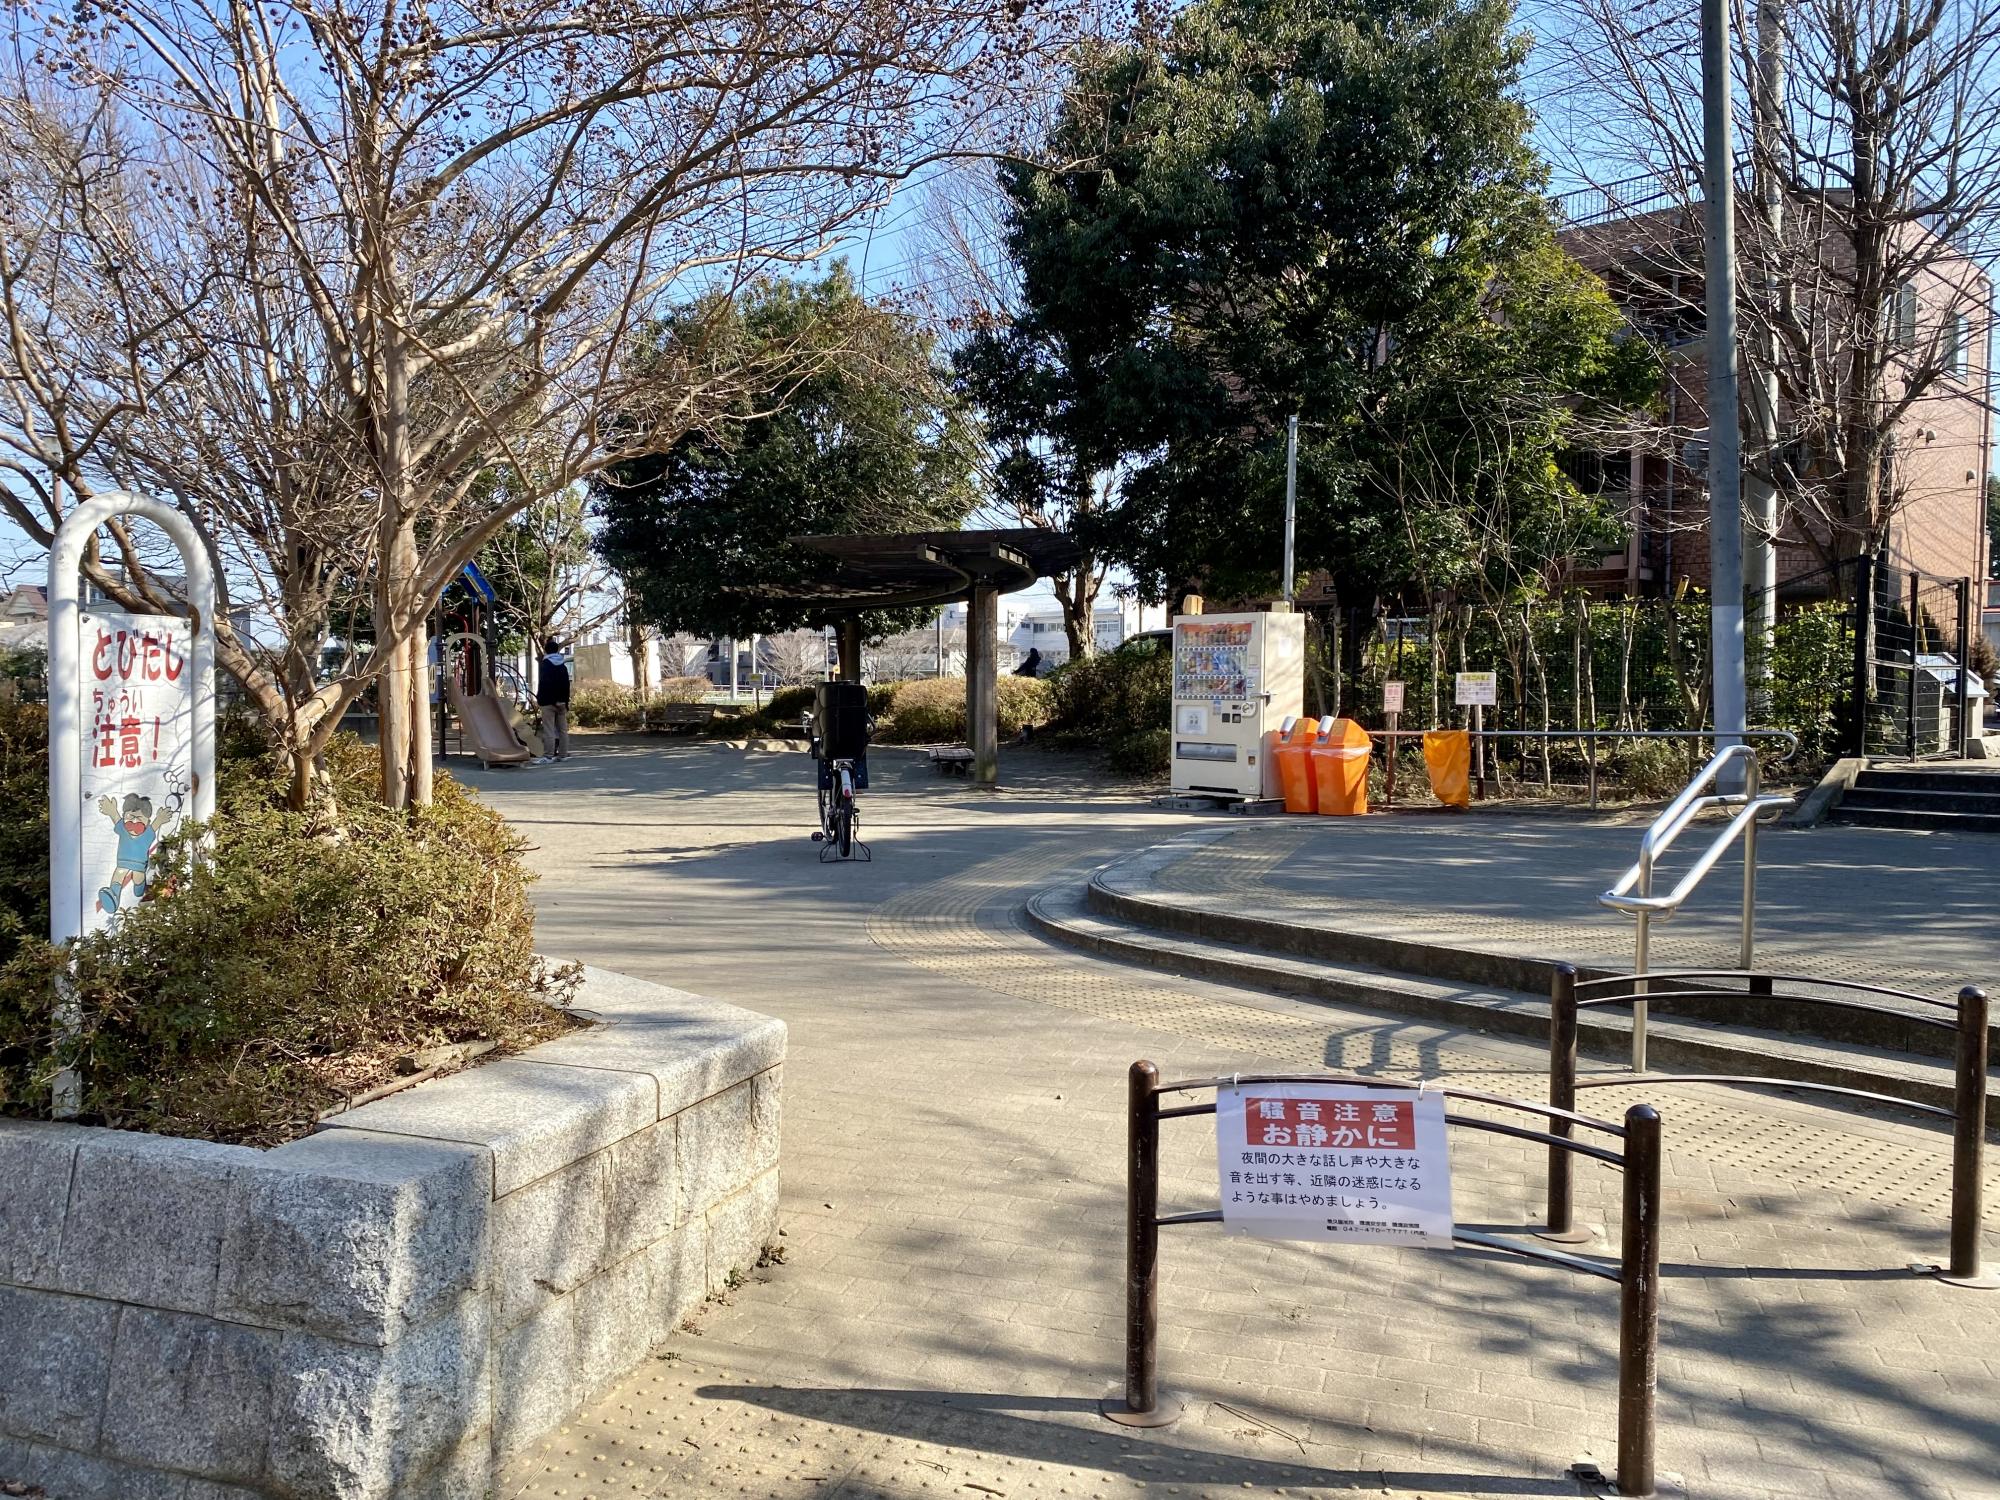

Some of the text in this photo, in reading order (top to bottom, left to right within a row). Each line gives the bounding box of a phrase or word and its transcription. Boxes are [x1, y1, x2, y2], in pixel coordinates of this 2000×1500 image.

[92, 628, 184, 681] とびだし
[92, 688, 143, 713] ちゅうい
[92, 714, 160, 768] 注意！
[1259, 1101, 1399, 1123] 騒音注意
[1262, 1124, 1399, 1147] お静かに
[1241, 1152, 1421, 1170] 夜間の大きな話し声や大きな
[1229, 1171, 1422, 1191] 音を出す等、近隣の迷惑になる
[1231, 1191, 1389, 1210] ような事はやめましょう。
